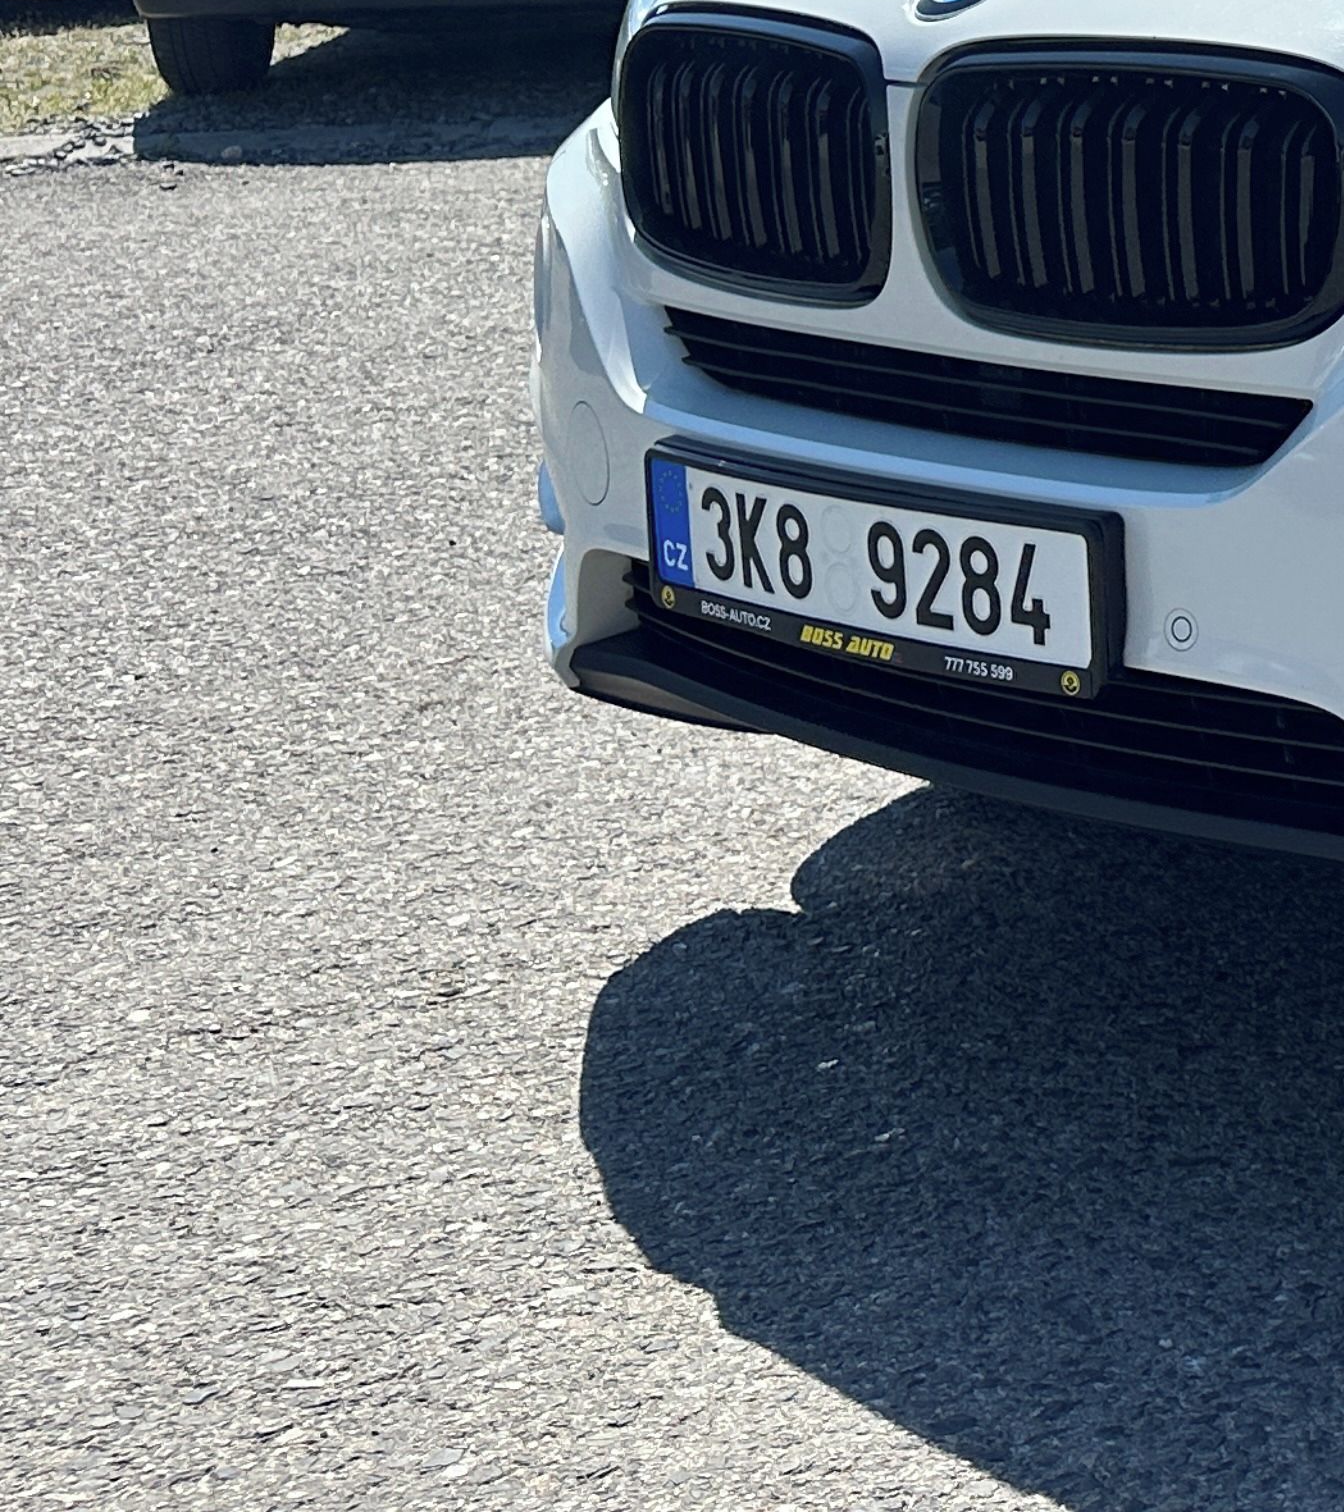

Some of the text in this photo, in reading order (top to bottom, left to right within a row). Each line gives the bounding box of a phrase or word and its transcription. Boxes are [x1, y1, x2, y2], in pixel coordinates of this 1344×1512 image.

[663, 539, 688, 571] CZ
[701, 486, 1052, 646] 3K8 9284
[701, 600, 772, 631] BOSS-AUTO.CZ
[800, 624, 895, 661] BOSS AUTO
[966, 661, 989, 677] 755
